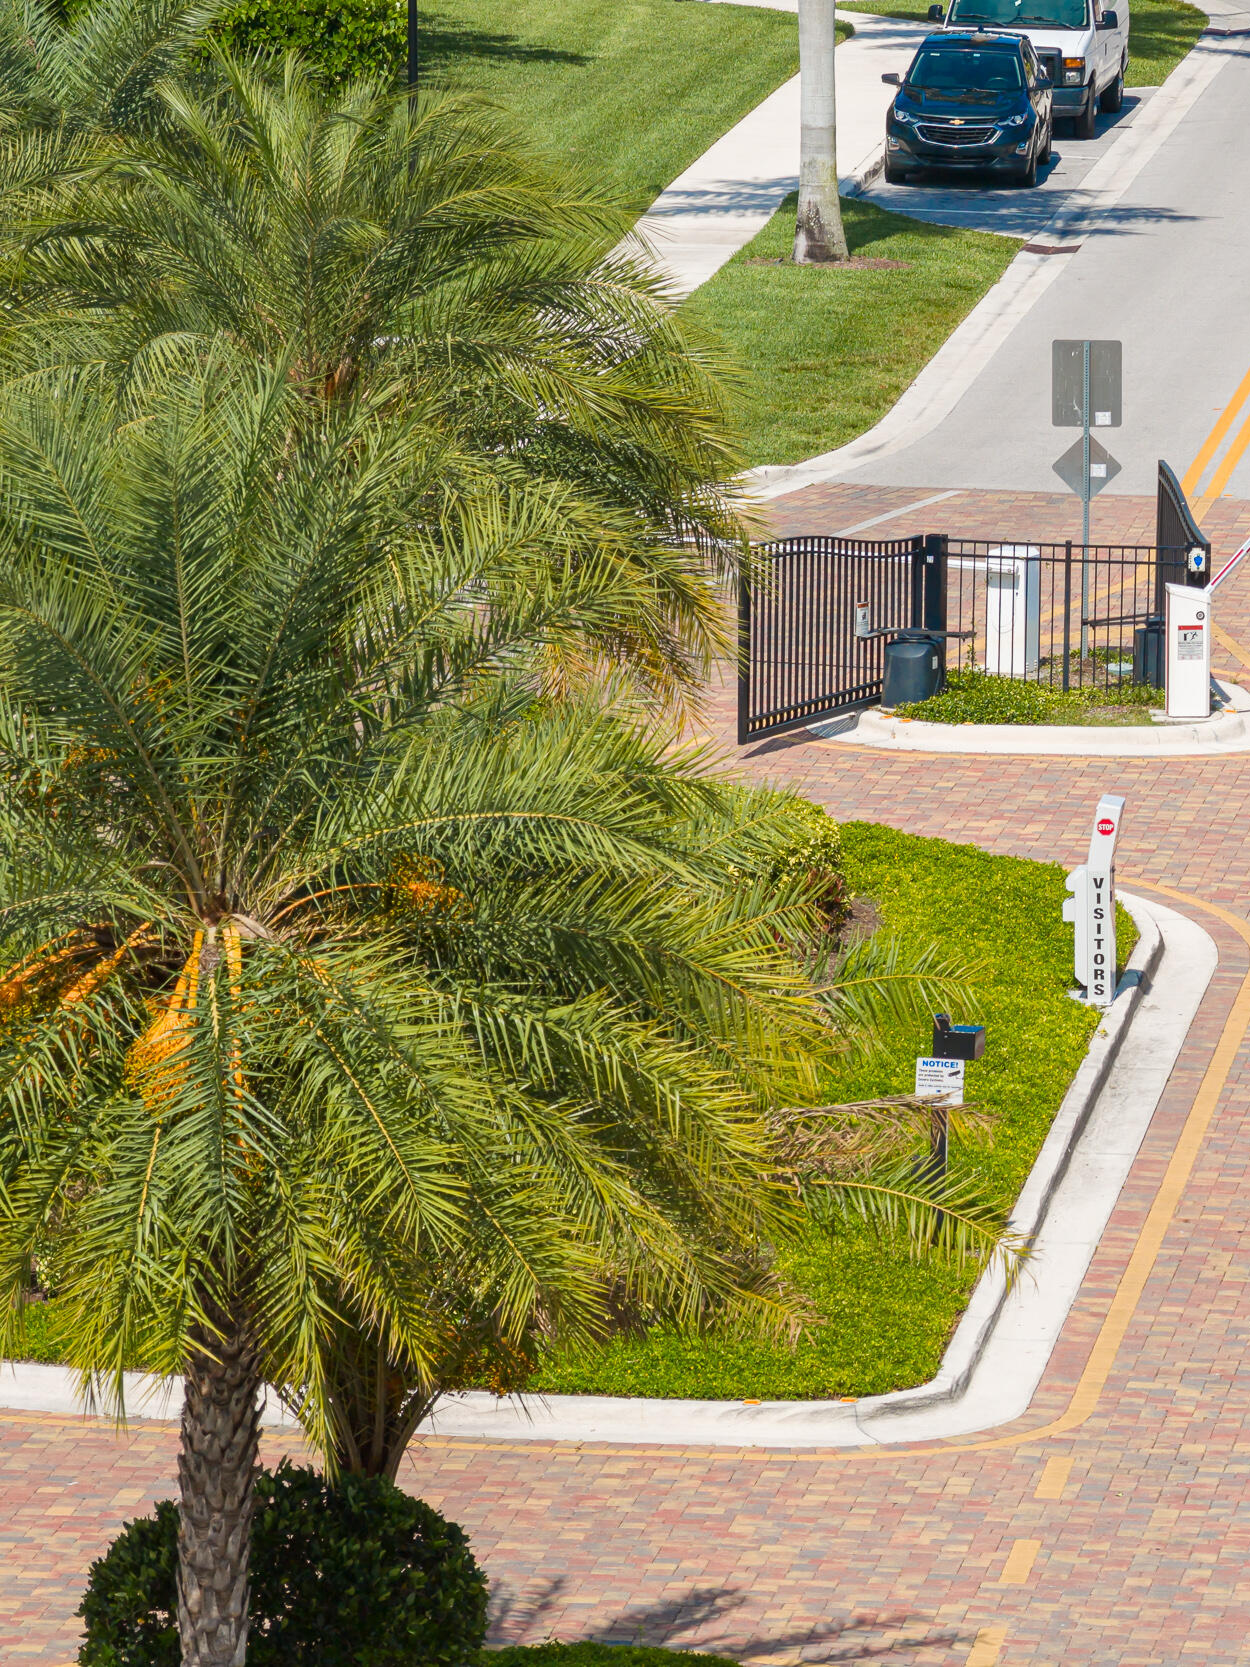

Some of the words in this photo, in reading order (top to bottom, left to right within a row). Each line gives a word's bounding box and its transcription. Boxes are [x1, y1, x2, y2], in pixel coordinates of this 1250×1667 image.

[1098, 823, 1114, 831] STOP
[1093, 877, 1105, 996] VISITORS
[922, 1060, 959, 1069] NOTICE!
